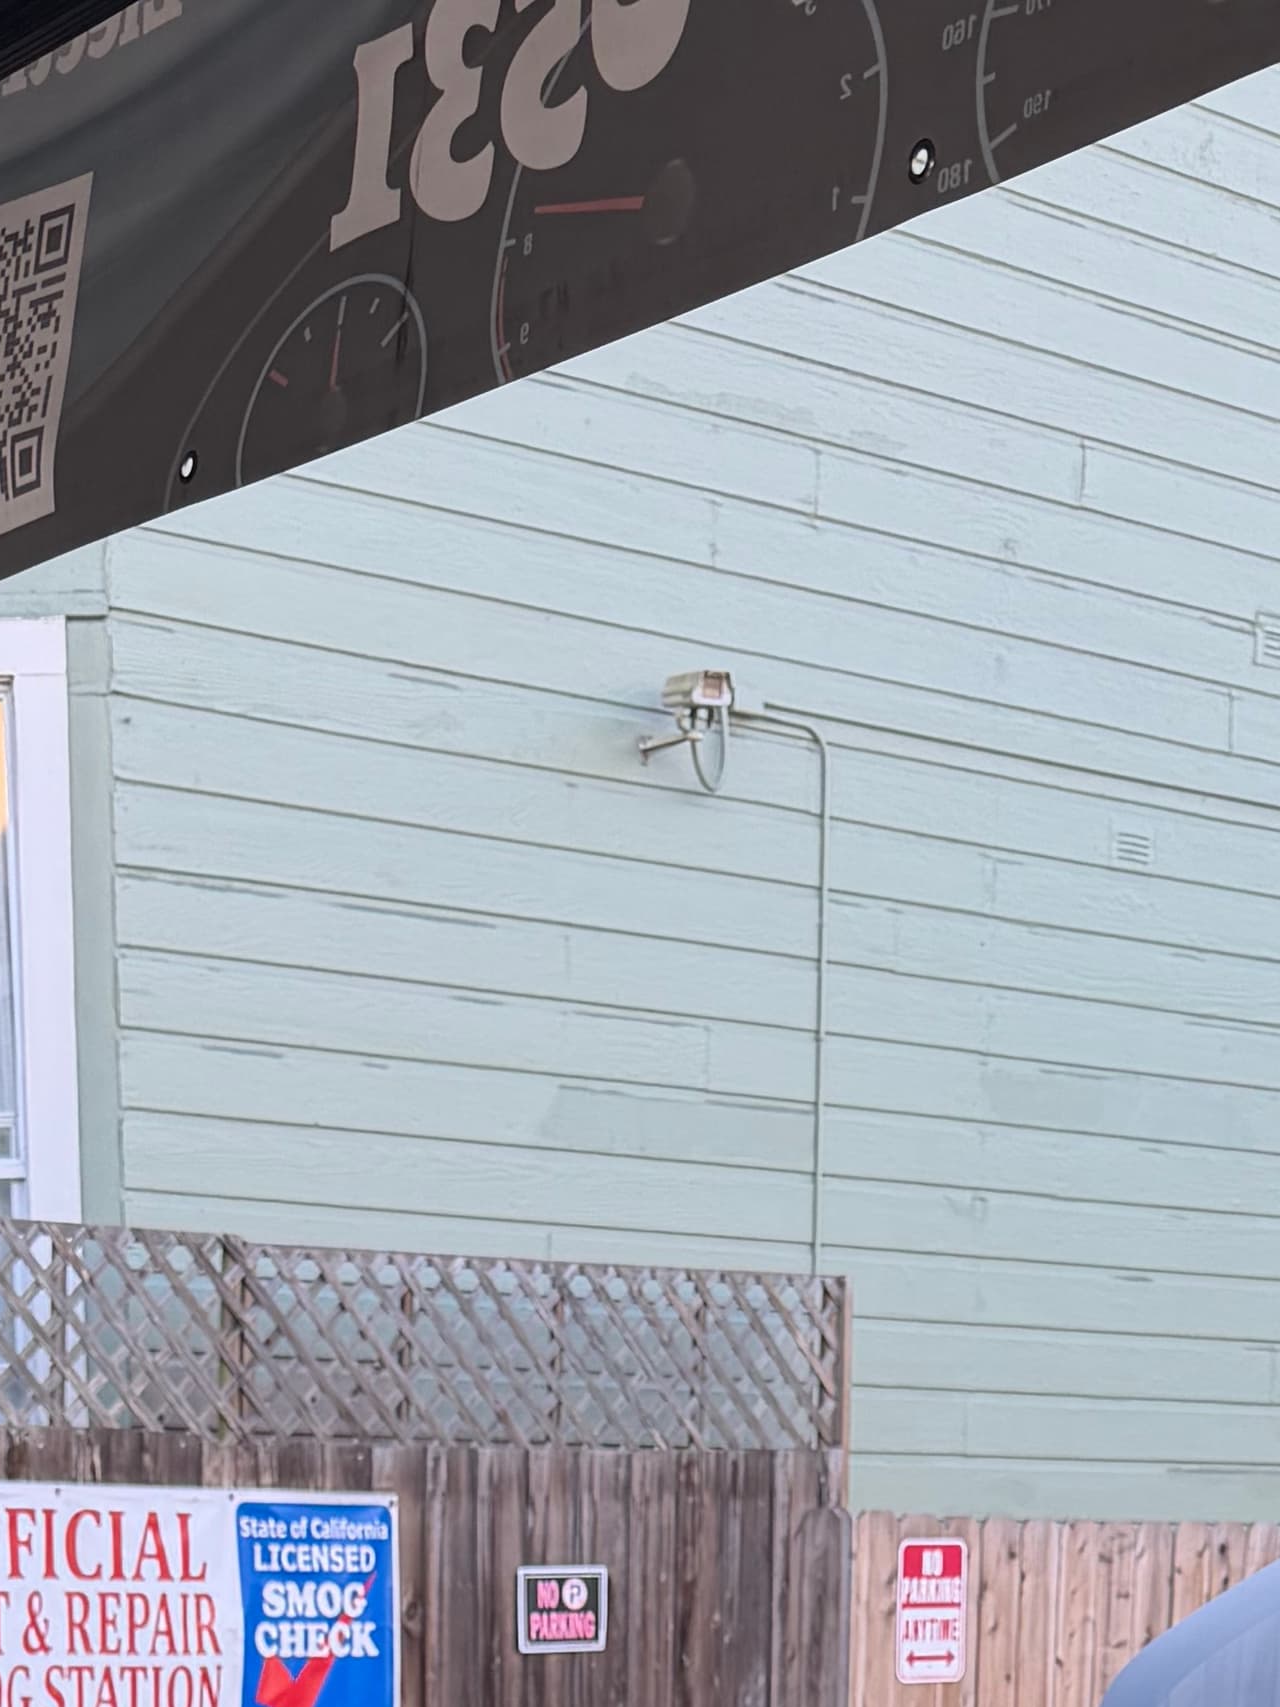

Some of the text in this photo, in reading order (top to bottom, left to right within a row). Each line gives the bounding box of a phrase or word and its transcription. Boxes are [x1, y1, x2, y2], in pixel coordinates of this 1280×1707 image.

[239, 1515, 389, 1541] State of California
[253, 1542, 377, 1574] LICENSED
[262, 1580, 368, 1618] SMOG
[537, 1579, 560, 1609] NO
[22, 1590, 52, 1655] &
[65, 1591, 223, 1656] REPAIR
[254, 1620, 380, 1658] CHECK
[529, 1610, 597, 1641] PARKING
